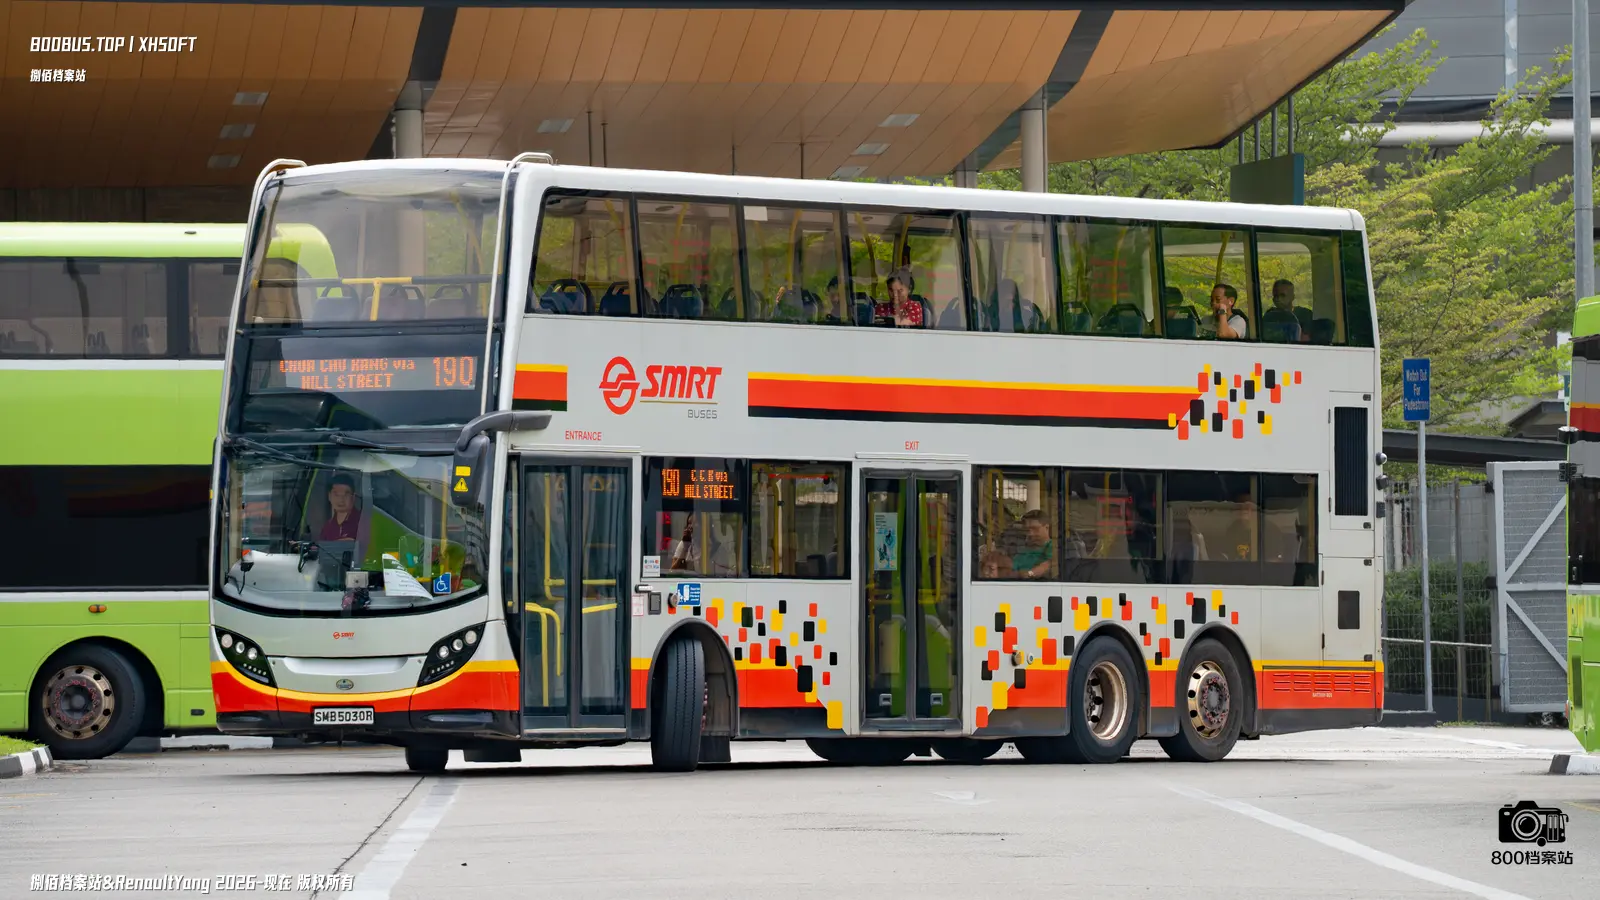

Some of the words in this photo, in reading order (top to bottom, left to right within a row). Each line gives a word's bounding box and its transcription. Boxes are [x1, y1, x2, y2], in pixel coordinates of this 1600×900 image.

[279, 359, 315, 373] CHUA
[319, 359, 347, 372] CHU
[351, 358, 388, 371] KANG
[392, 359, 416, 371] via
[432, 356, 474, 387] 190
[301, 375, 332, 389] HILL
[337, 373, 394, 388] STREET
[640, 365, 722, 399] SMRT
[687, 409, 718, 419] BUSES
[565, 430, 602, 441] ENTRANCE
[905, 440, 920, 451] EXIT
[661, 469, 680, 496] 190
[684, 484, 702, 499] HILL
[703, 485, 734, 499] STREET
[315, 711, 373, 722] SMB5030R
